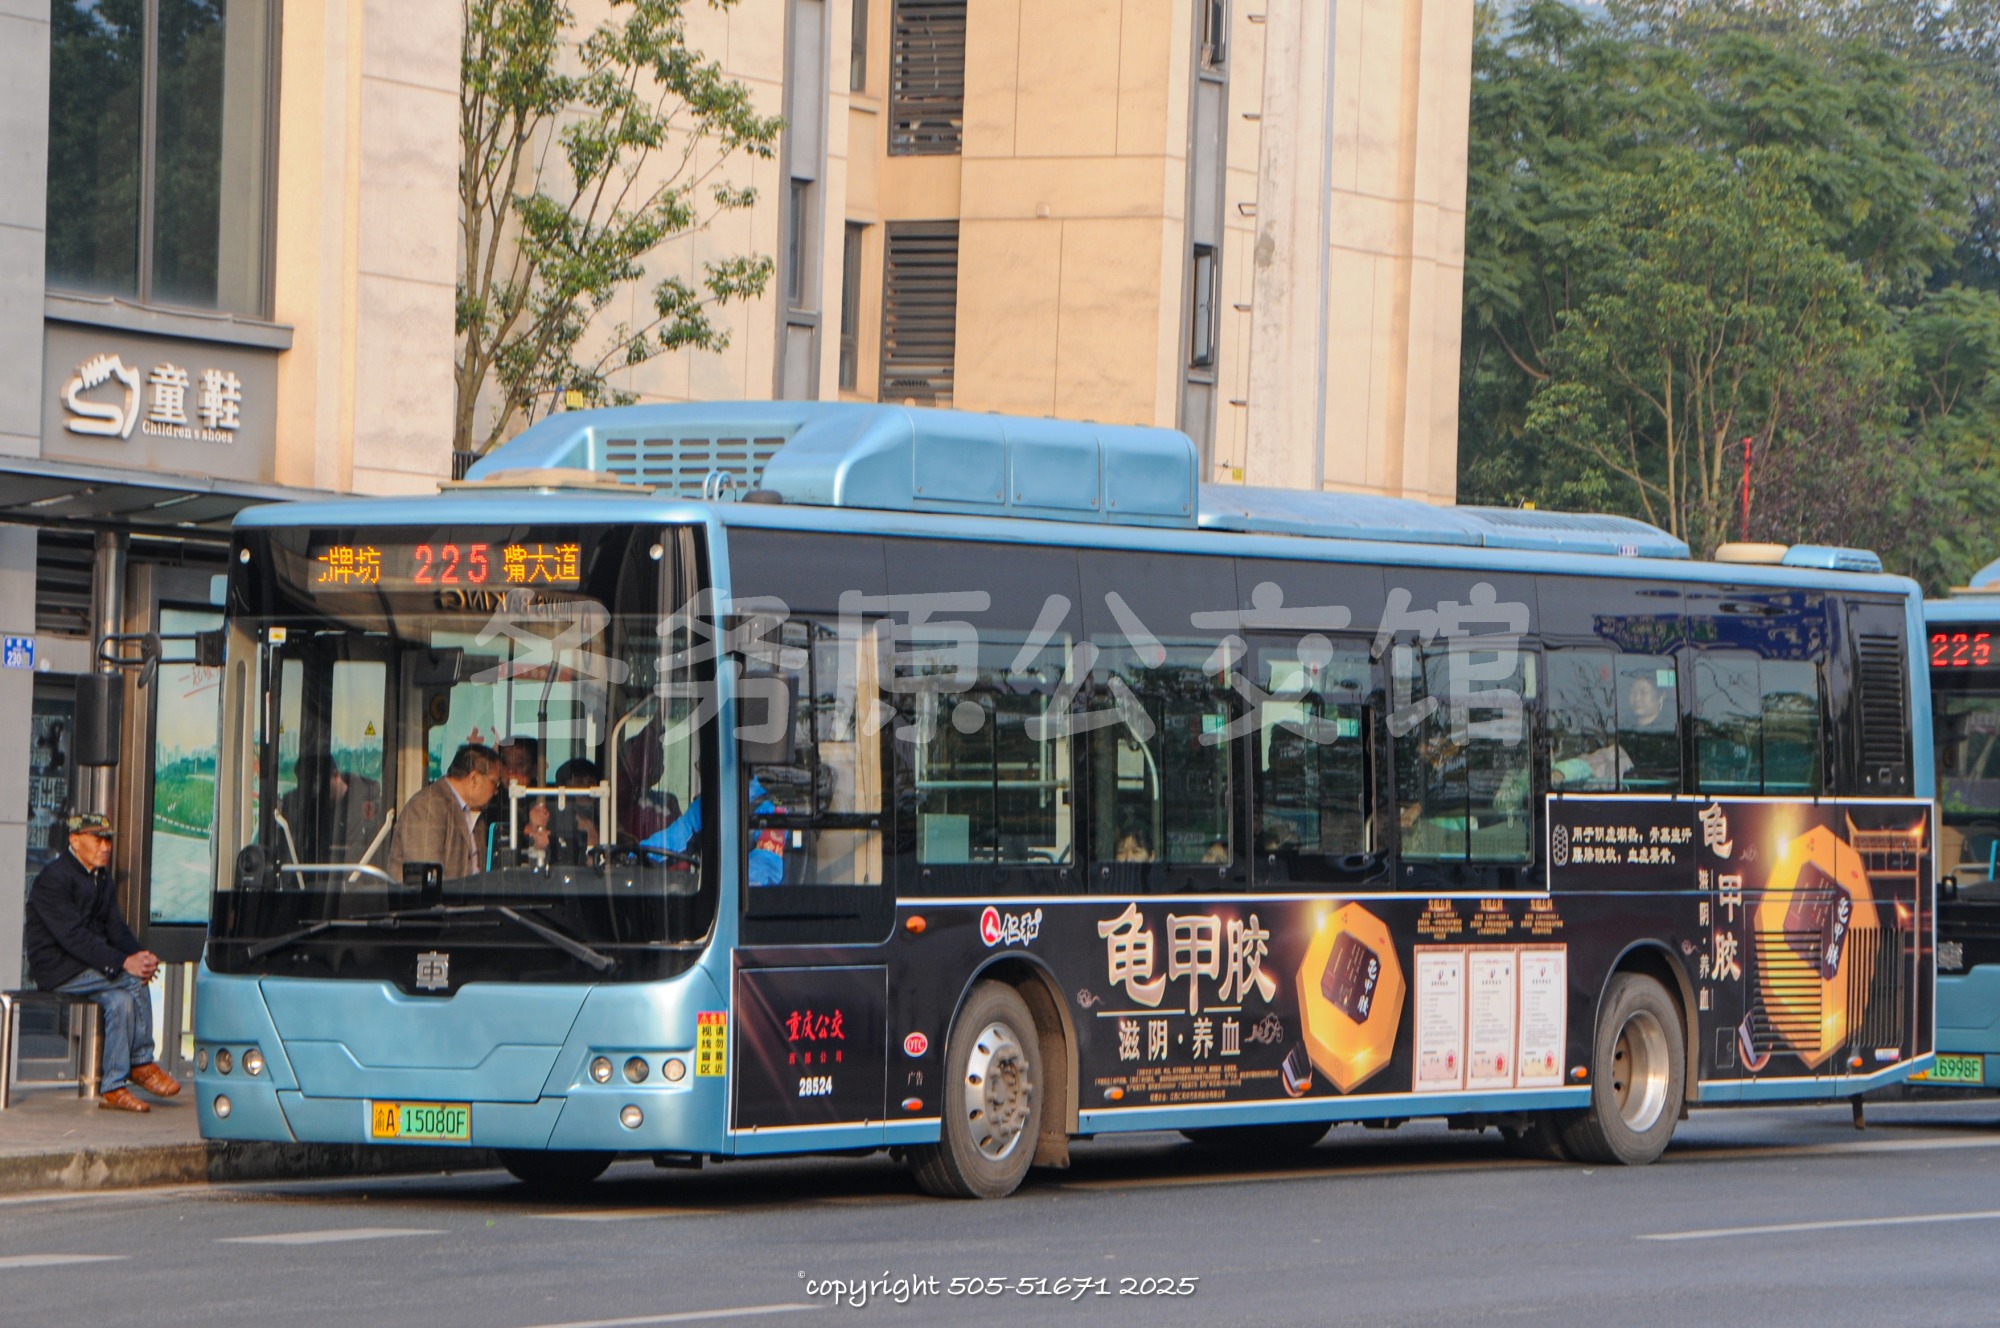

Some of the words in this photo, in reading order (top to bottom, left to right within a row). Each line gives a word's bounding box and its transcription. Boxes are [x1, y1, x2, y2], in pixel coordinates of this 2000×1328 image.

[147, 363, 242, 430] 童鞋
[142, 420, 192, 440] Children
[201, 427, 233, 444] shoes
[415, 544, 488, 584] 225
[1931, 633, 1991, 667] 225
[1698, 801, 1743, 982] 龟甲胶
[1097, 902, 1277, 1016] 龟甲胶
[786, 1008, 846, 1042] 重庆公交
[700, 1025, 712, 1074] 视线盲区
[715, 1025, 724, 1074] 请勿靠近
[905, 1036, 927, 1053] OTC
[799, 1075, 833, 1097] 28524
[907, 1070, 924, 1086] 广告
[406, 1109, 466, 1134] 15080F
